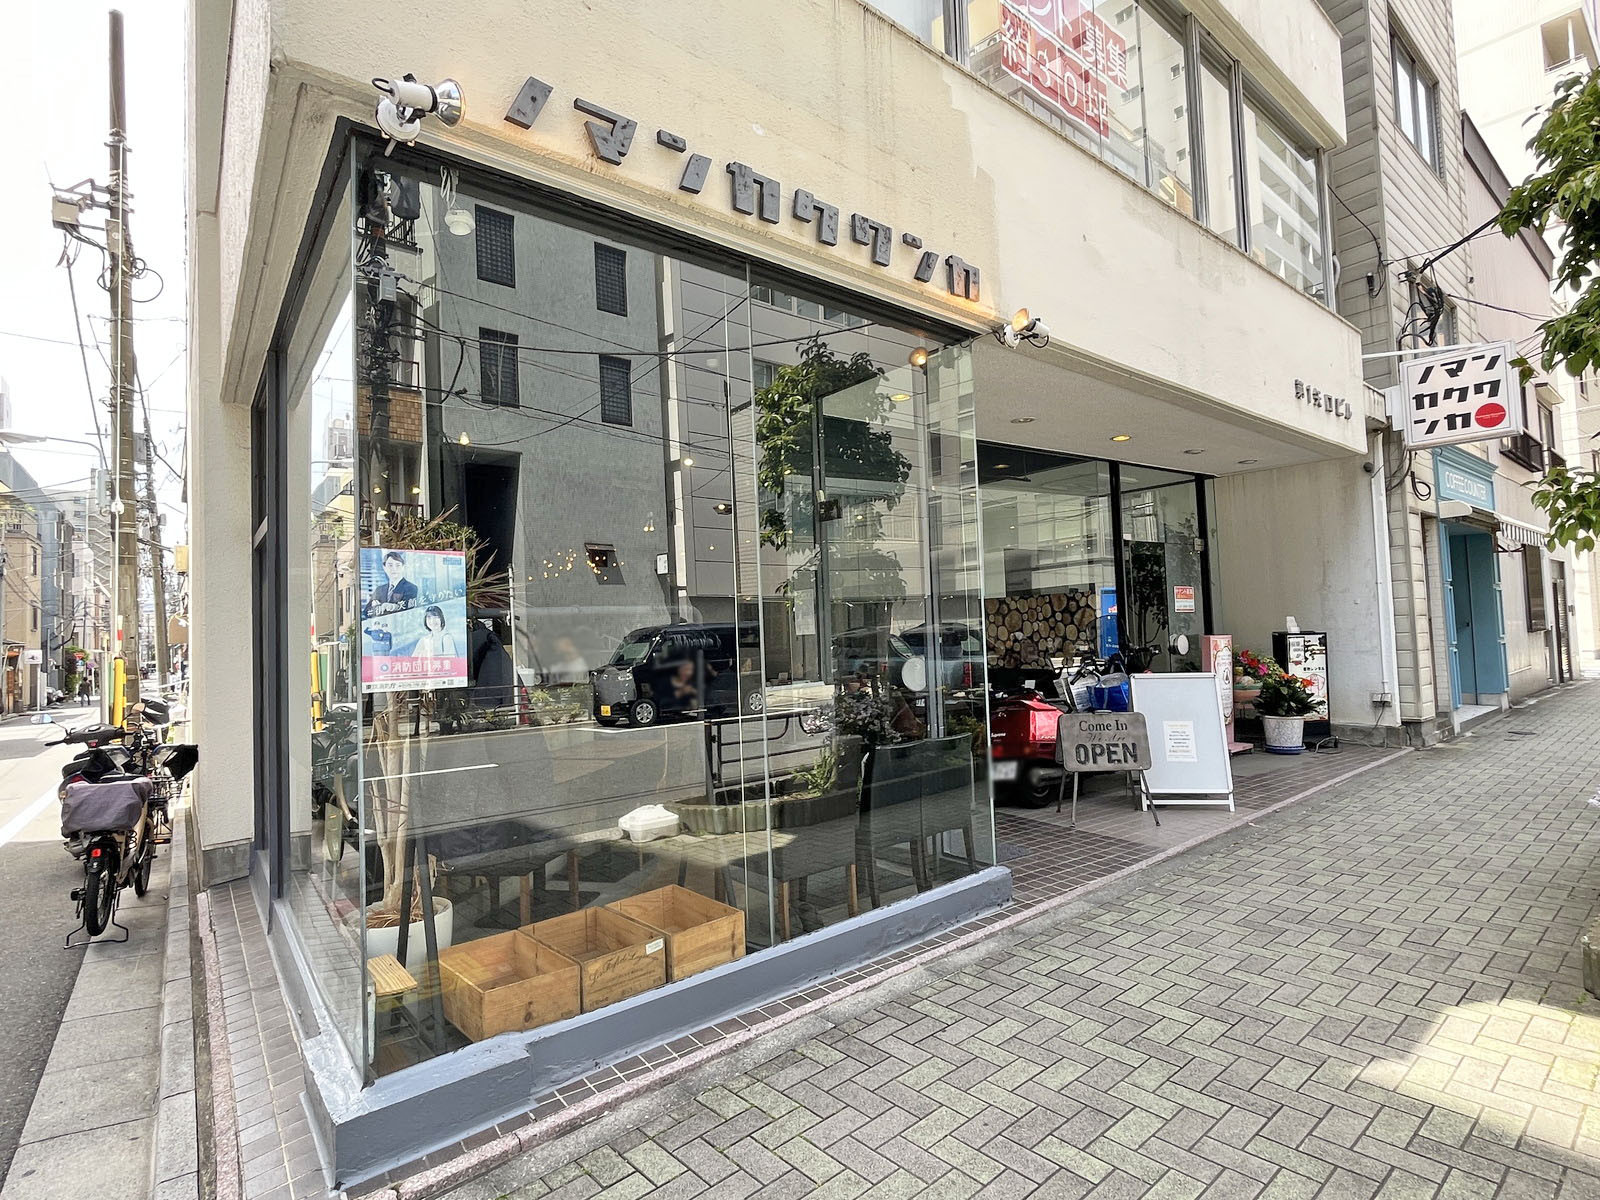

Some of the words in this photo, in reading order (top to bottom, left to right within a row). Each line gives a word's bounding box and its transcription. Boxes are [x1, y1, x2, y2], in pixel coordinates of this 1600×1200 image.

[1418, 354, 1502, 385] ノマン
[1412, 379, 1502, 411] カクワ
[1413, 411, 1472, 435] ンカ
[1079, 720, 1112, 732] Come
[1115, 720, 1128, 731] In
[1075, 742, 1139, 765] OPEN
